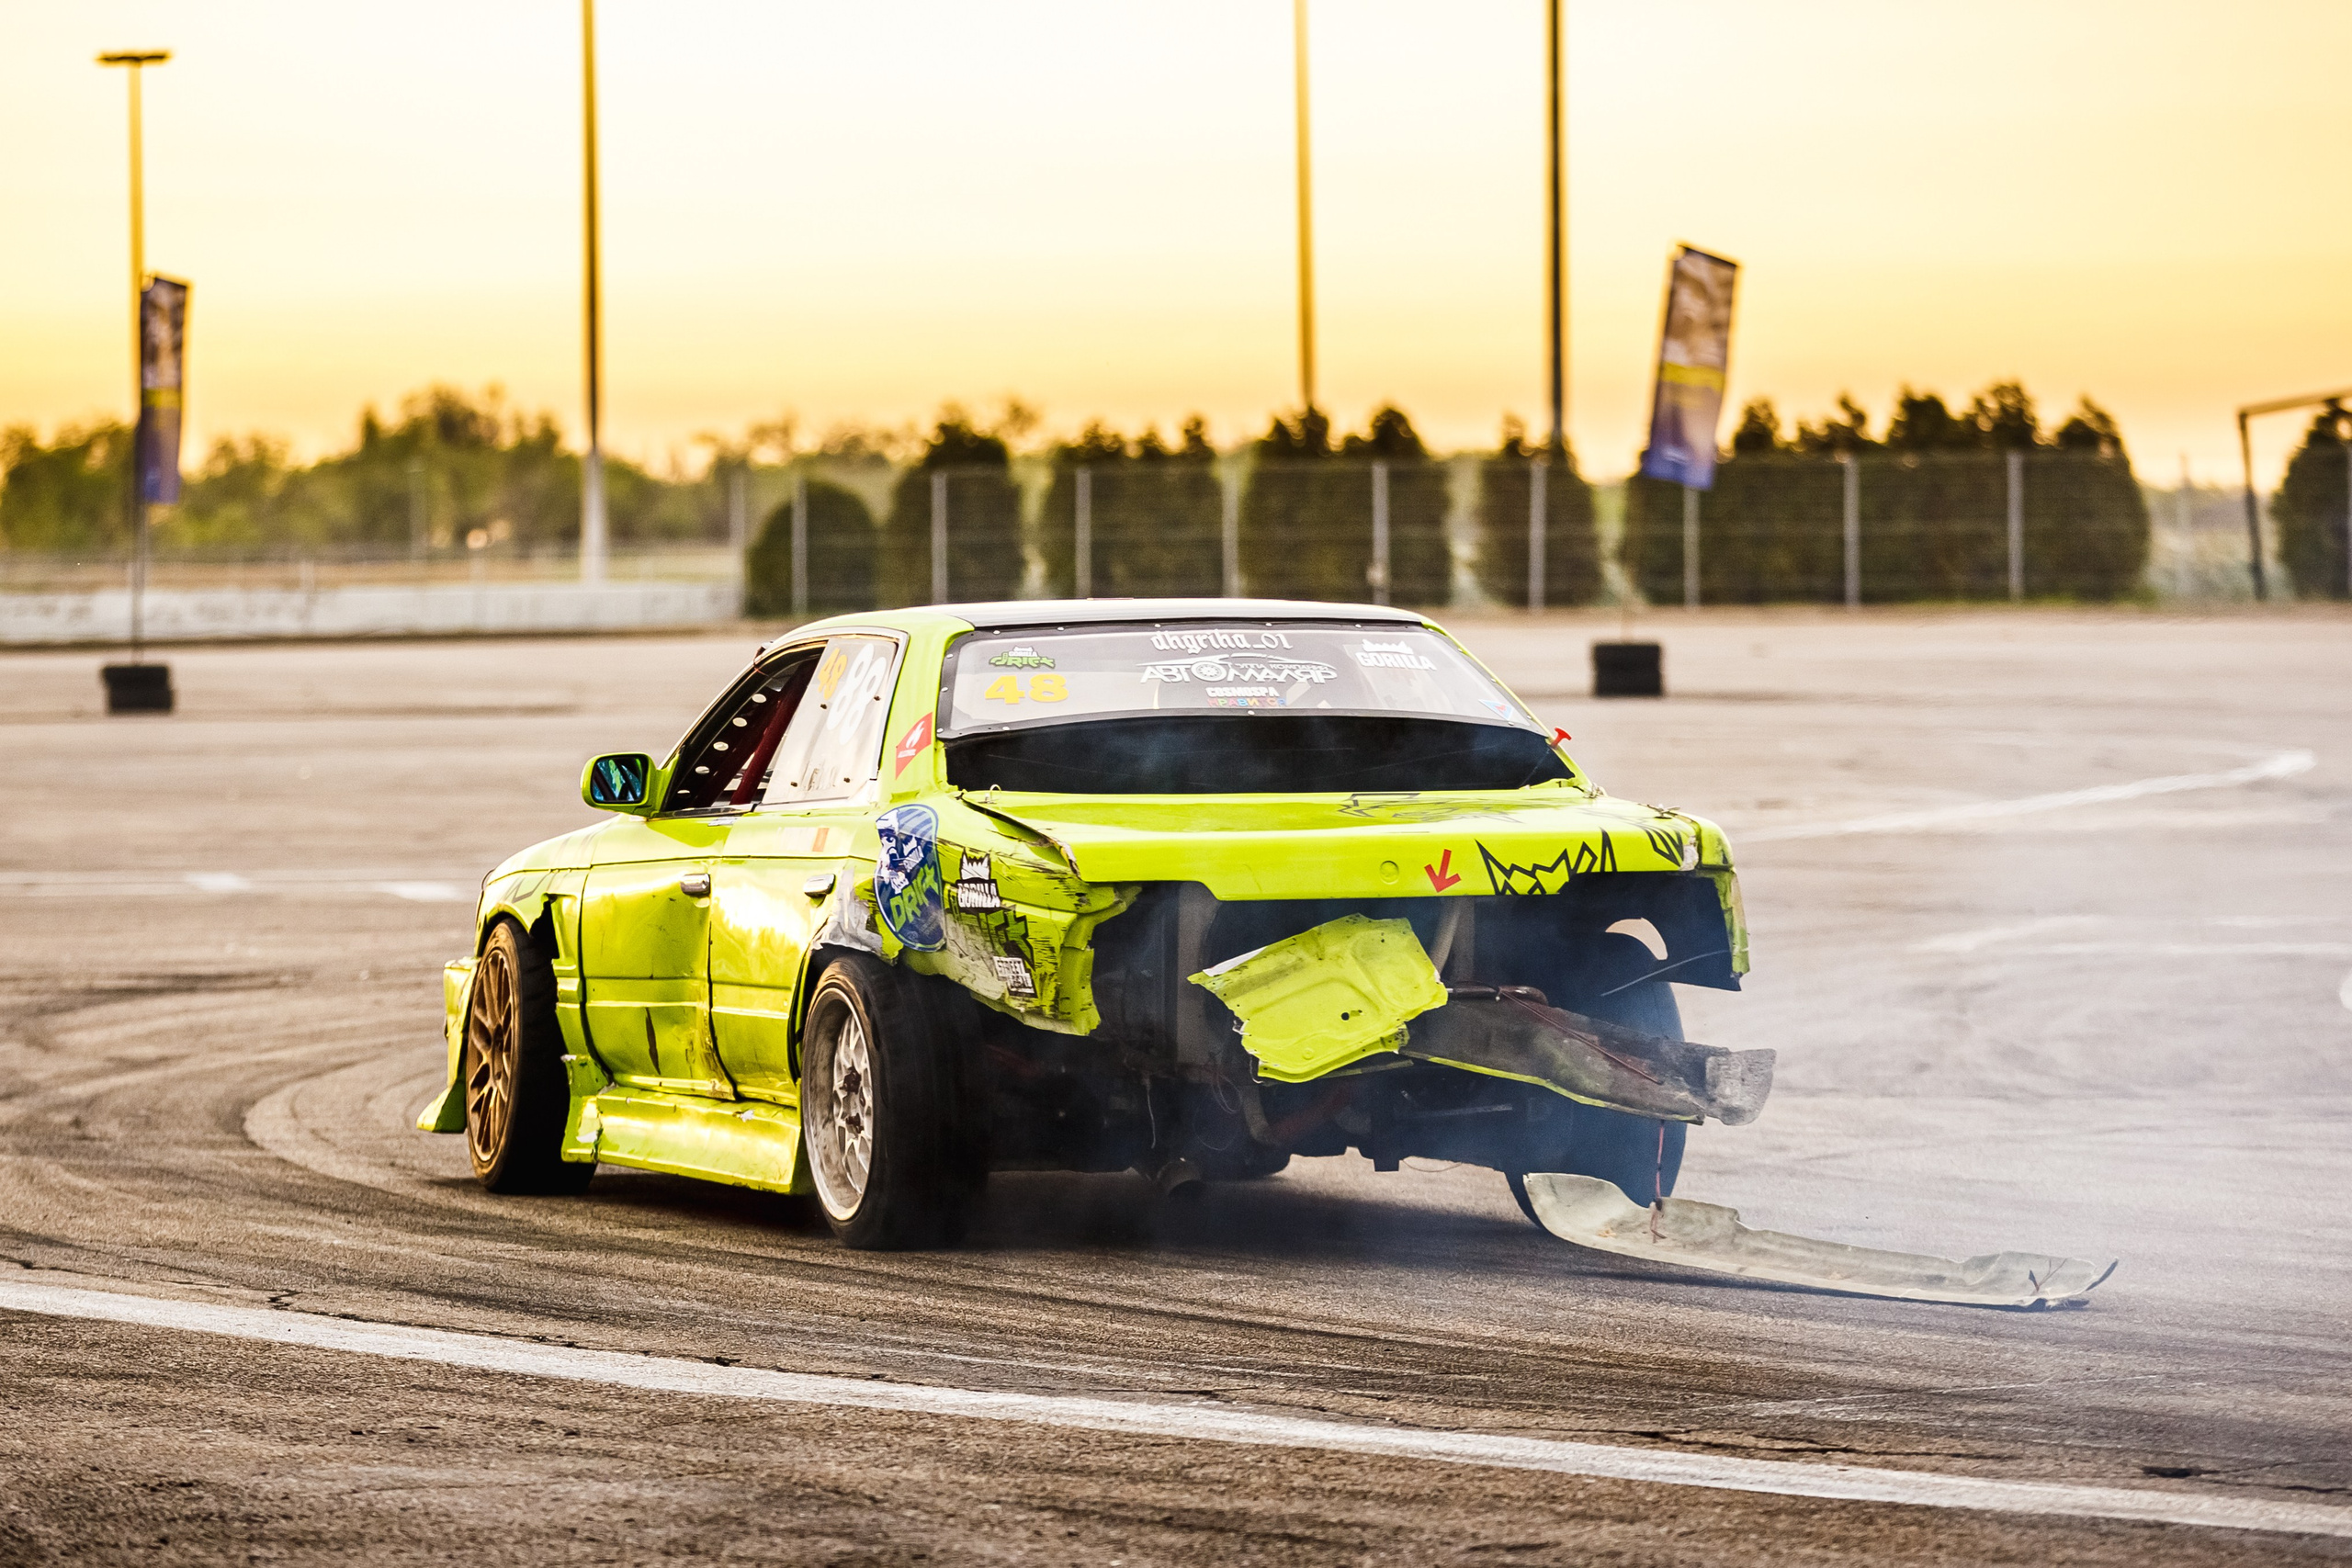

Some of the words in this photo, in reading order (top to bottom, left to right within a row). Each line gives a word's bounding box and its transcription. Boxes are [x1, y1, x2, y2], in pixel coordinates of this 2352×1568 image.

[817, 647, 847, 700] 48
[1140, 660, 1339, 683] АВТОМАЛЯР
[1355, 651, 1438, 671] GORILLA
[985, 673, 1069, 705] 48
[956, 883, 1001, 908] GORILLA
